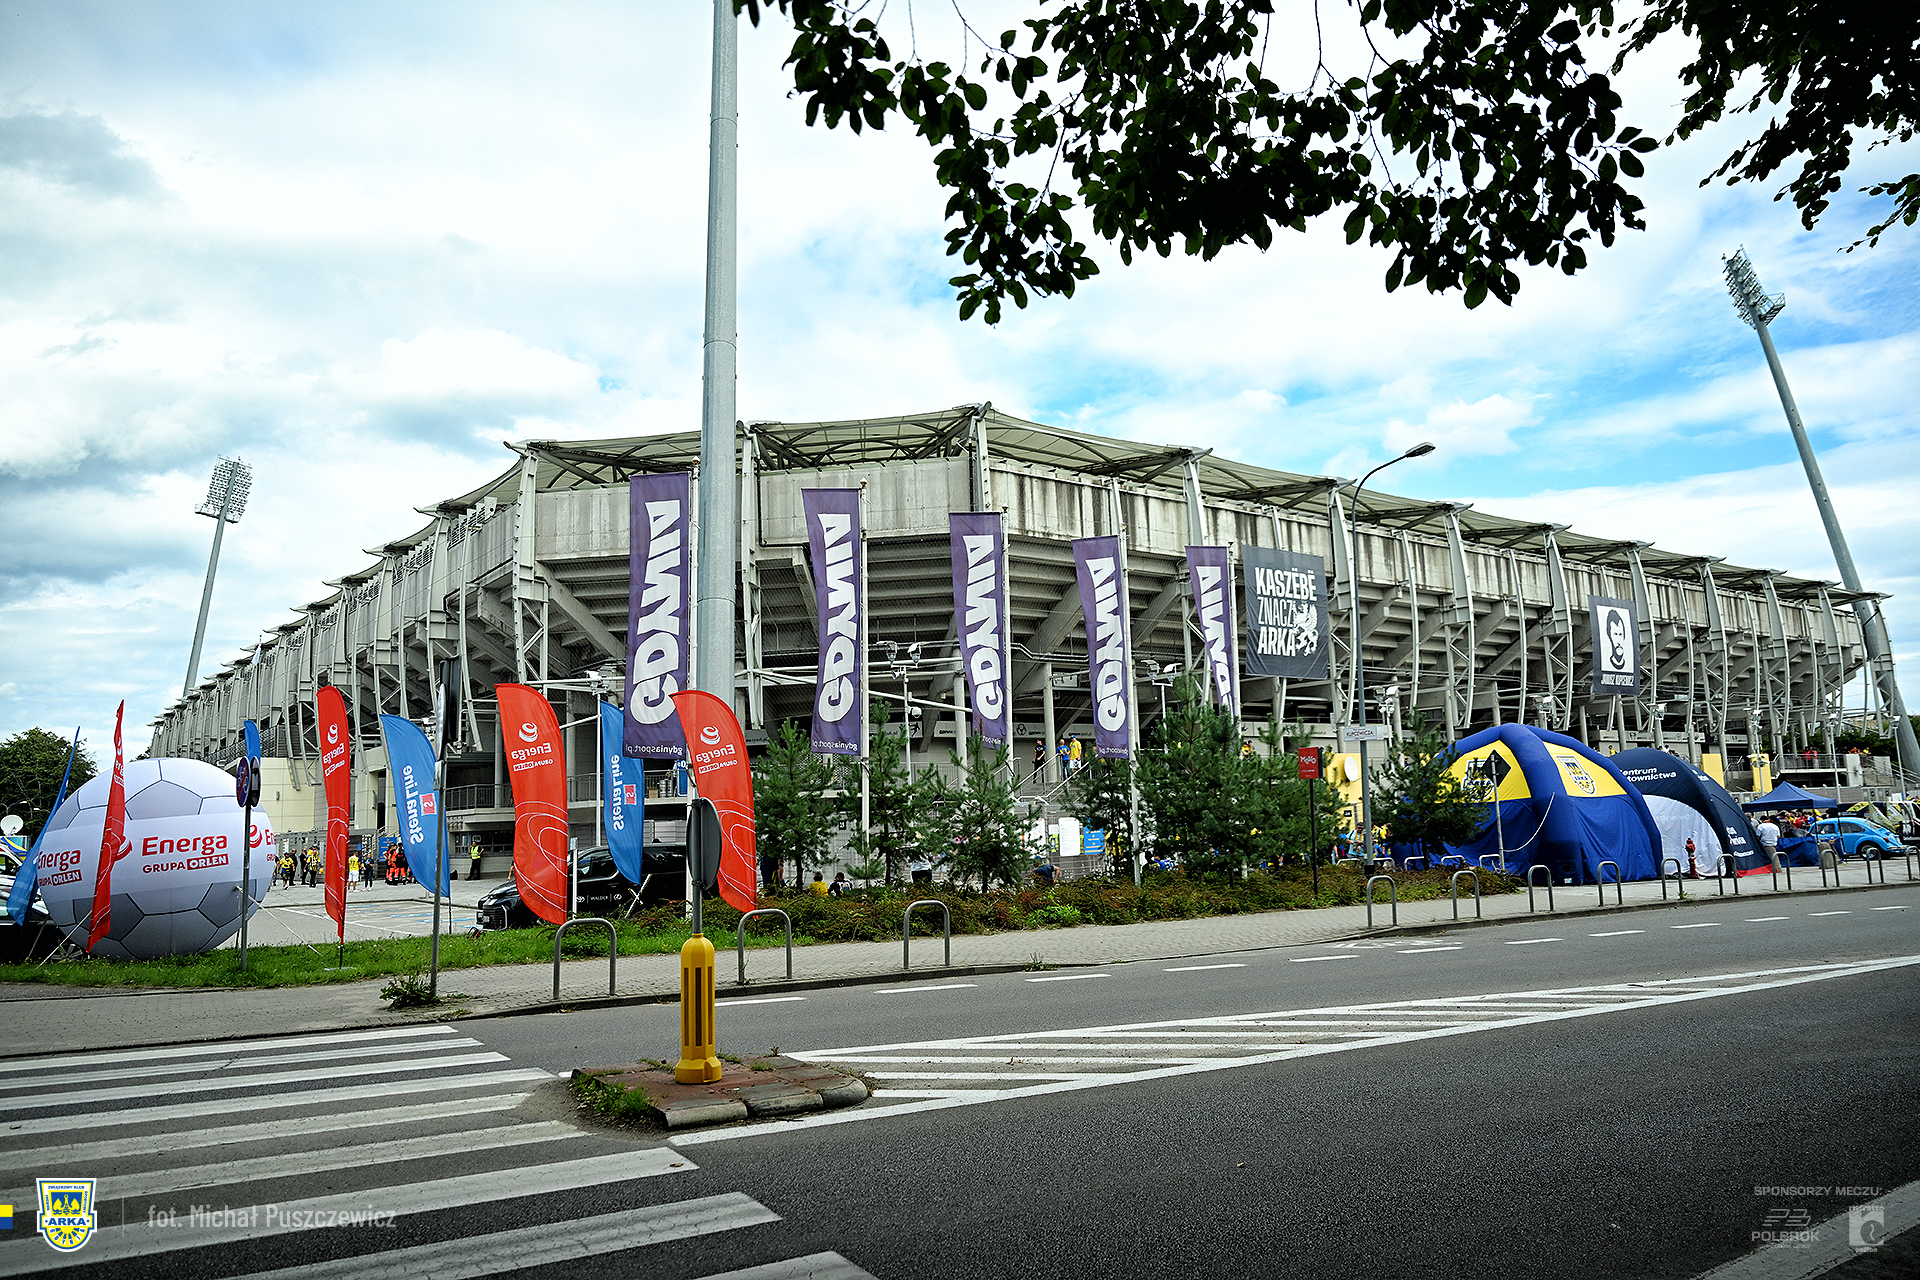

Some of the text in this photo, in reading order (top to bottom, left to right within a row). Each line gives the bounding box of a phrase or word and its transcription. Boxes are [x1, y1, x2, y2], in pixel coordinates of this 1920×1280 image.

[1254, 566, 1318, 601] KASZËBË
[1257, 627, 1296, 657] ARKA
[1627, 771, 1677, 782] townictwa
[142, 835, 228, 856] Energa
[37, 849, 81, 871] Energa
[142, 855, 227, 873] GRUPA ORLEN
[53, 871, 80, 882] ORLEN
